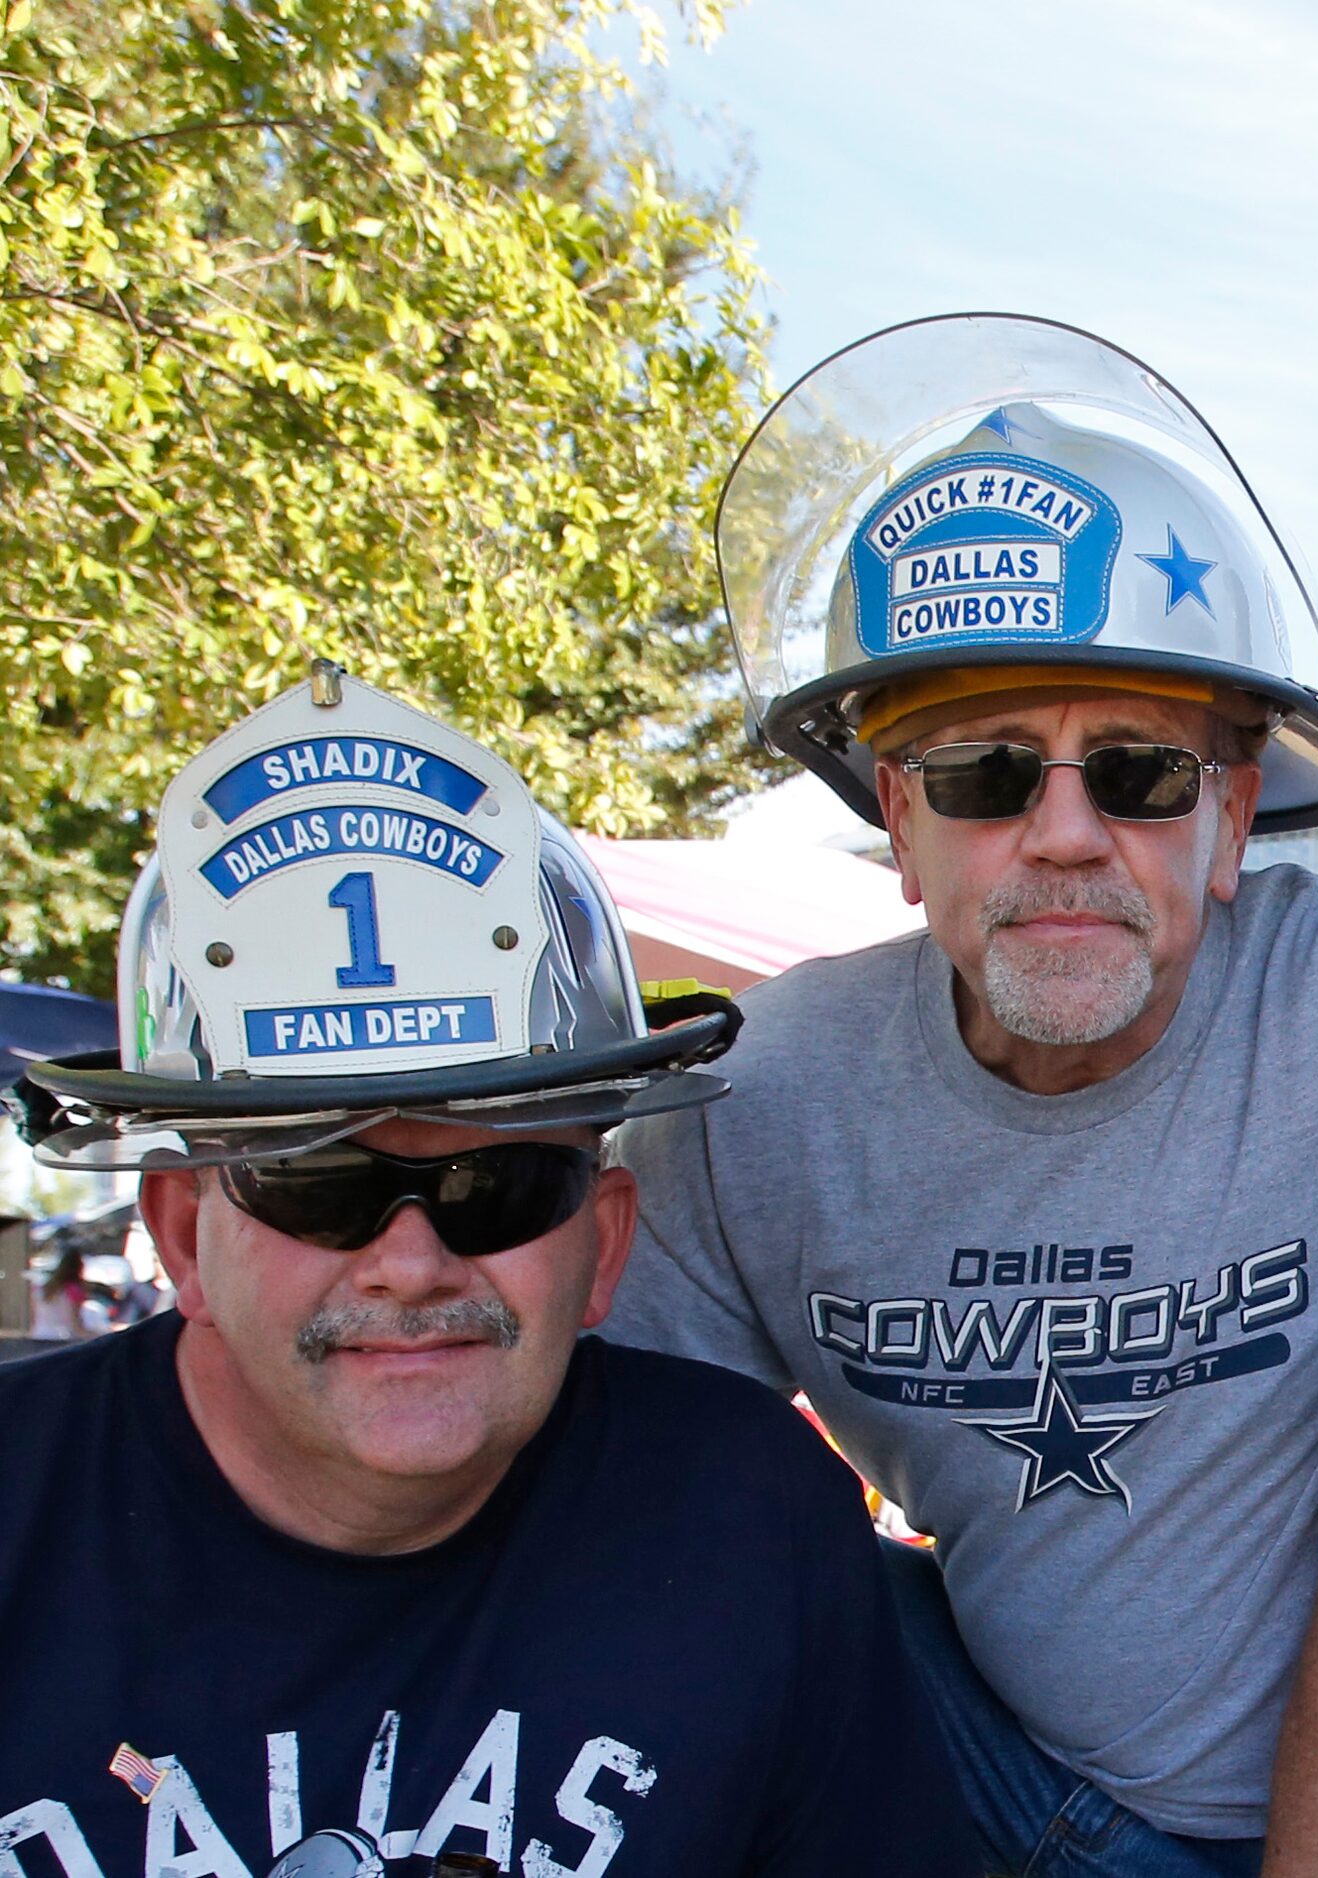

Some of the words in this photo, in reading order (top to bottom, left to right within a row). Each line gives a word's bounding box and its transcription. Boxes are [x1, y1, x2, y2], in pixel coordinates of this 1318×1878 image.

[879, 475, 969, 550] QUICK
[976, 474, 1085, 531] #1FAN
[911, 549, 1039, 588] DALLAS
[897, 597, 1051, 638] COWBOYS
[262, 742, 427, 790] SHADIX
[225, 818, 331, 884] DALLAS
[340, 813, 484, 876] COWBOYS
[328, 871, 396, 989] 1
[274, 1009, 355, 1052] FAN
[366, 1004, 467, 1045] DEPT
[949, 1244, 1133, 1288] Dallas
[808, 1238, 1309, 1372] COWBOYS
[901, 1381, 964, 1404] NFC
[1131, 1357, 1220, 1396] EAST
